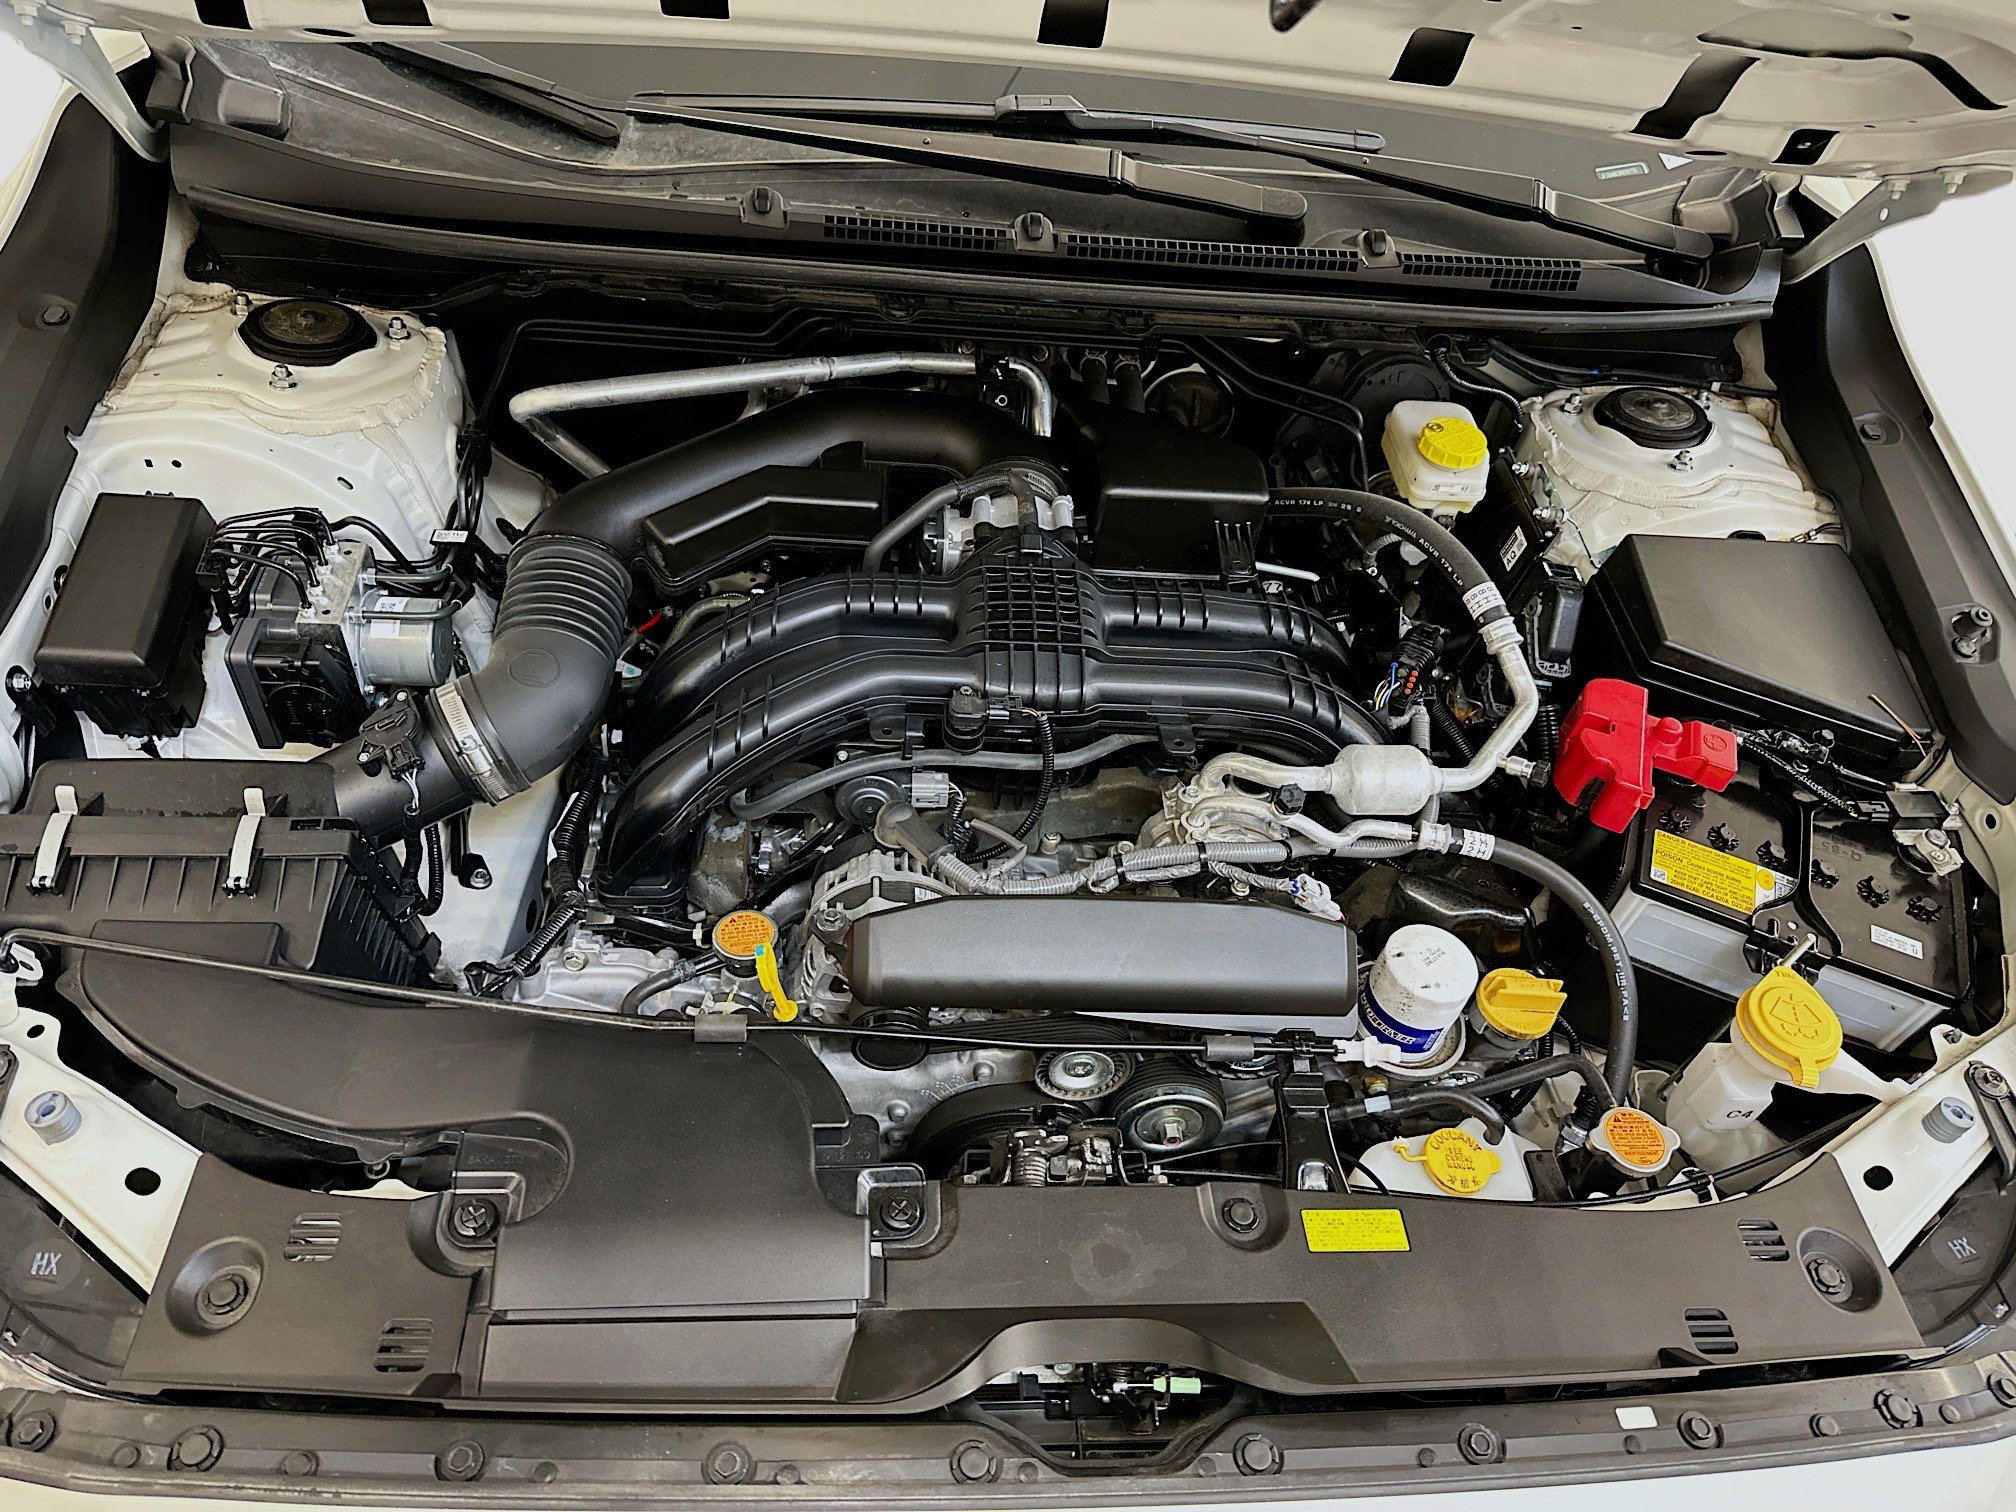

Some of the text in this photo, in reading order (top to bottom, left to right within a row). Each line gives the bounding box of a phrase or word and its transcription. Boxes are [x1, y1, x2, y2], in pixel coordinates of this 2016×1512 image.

[1418, 538, 1439, 558] ACVR
[1657, 831, 1685, 845] DANGER
[1655, 849, 1682, 863] POISON
[1686, 860, 1705, 871] CAUSES
[1702, 890, 1715, 899] CCA
[1726, 1110, 1754, 1119] C4
[1430, 1130, 1482, 1152] COOLANT
[1947, 1236, 1978, 1259] HX
[30, 1252, 62, 1275] HX
